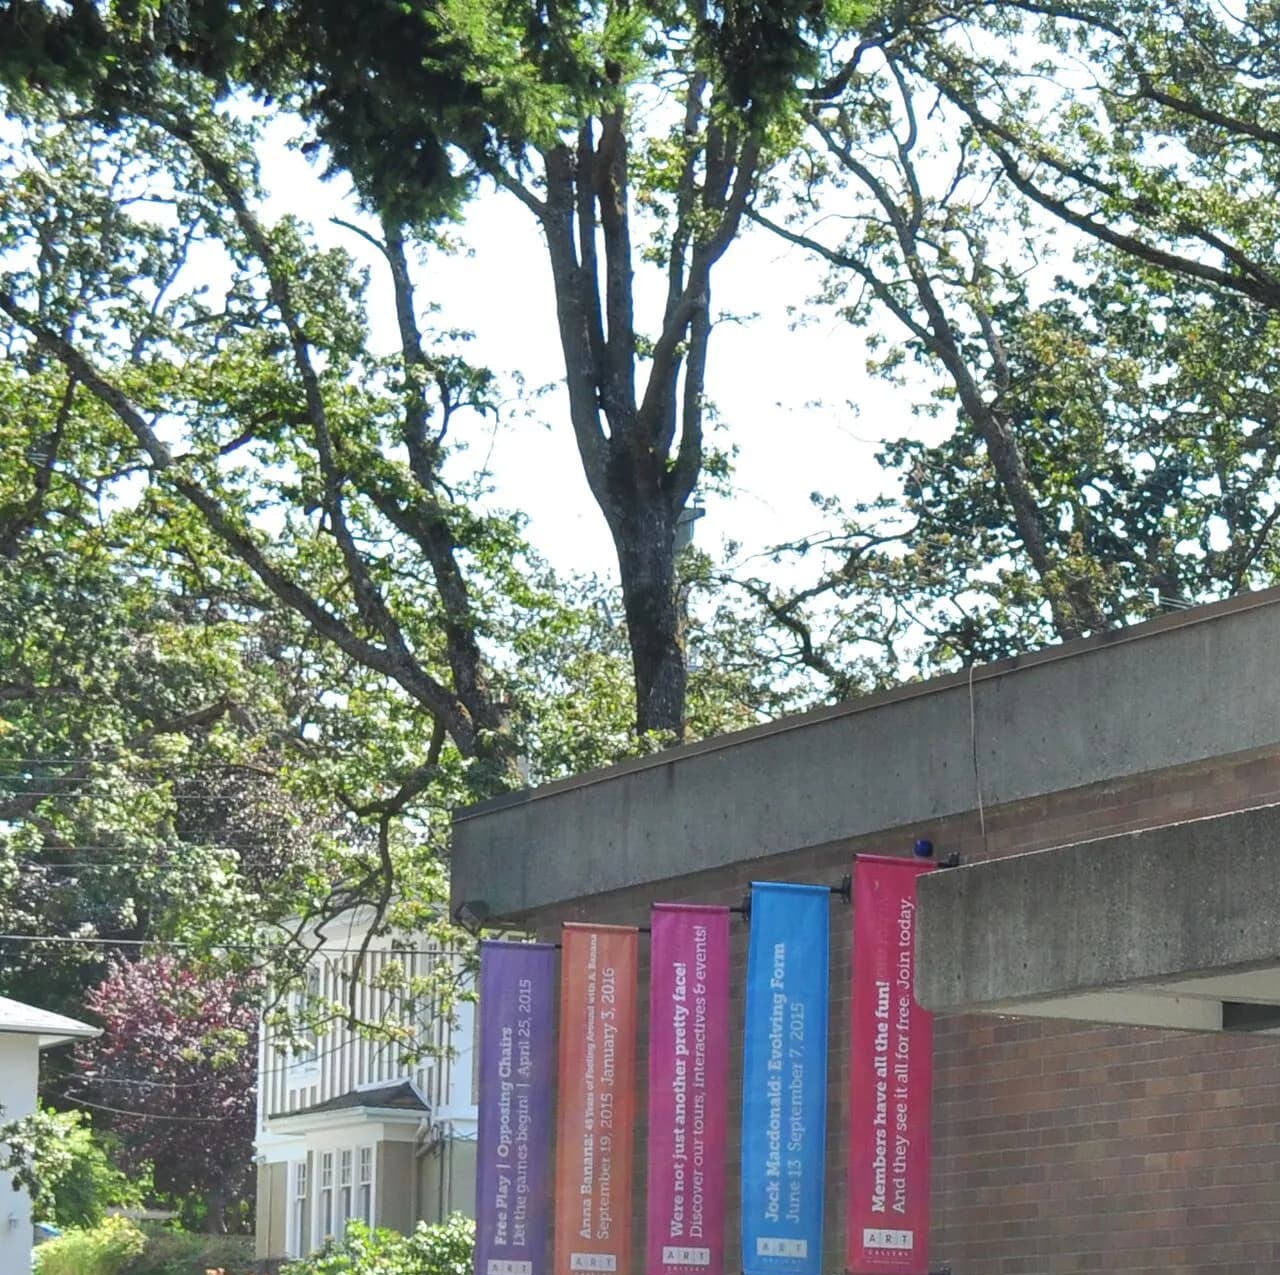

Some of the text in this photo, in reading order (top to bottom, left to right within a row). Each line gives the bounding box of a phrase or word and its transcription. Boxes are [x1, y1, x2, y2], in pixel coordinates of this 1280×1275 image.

[518, 979, 532, 1013] 2015
[587, 982, 596, 1004] with
[673, 962, 687, 1002] face!
[875, 981, 889, 1019] fun!
[518, 1017, 533, 1038] 25,
[673, 1004, 689, 1056] pretty
[874, 1022, 888, 1052] the
[498, 1026, 512, 1078] Chairs
[516, 1041, 533, 1077] April
[874, 1056, 887, 1078] all
[892, 895, 914, 1214] And they see it all for free. Join today.
[673, 1058, 686, 1125] another
[689, 925, 707, 1238] Discover our tours, interactives & events!
[765, 942, 787, 1222] Jock Macdonald: Evolving Form
[873, 1081, 887, 1125] have
[497, 1081, 514, 1158] Opposing
[515, 1095, 531, 1142] begin!
[597, 967, 617, 1240] September 19, 2015 January 3, 2016
[785, 1002, 805, 1224] June 13 September 7, 2015
[580, 1133, 593, 1194] Banana:
[672, 1128, 687, 1161] just
[516, 1144, 530, 1193] games
[673, 1163, 685, 1192] not
[871, 1129, 886, 1213] Members
[495, 1175, 511, 1209] Play
[514, 1196, 527, 1220] the
[494, 1212, 507, 1246] Free
[579, 1198, 592, 1240] Anna
